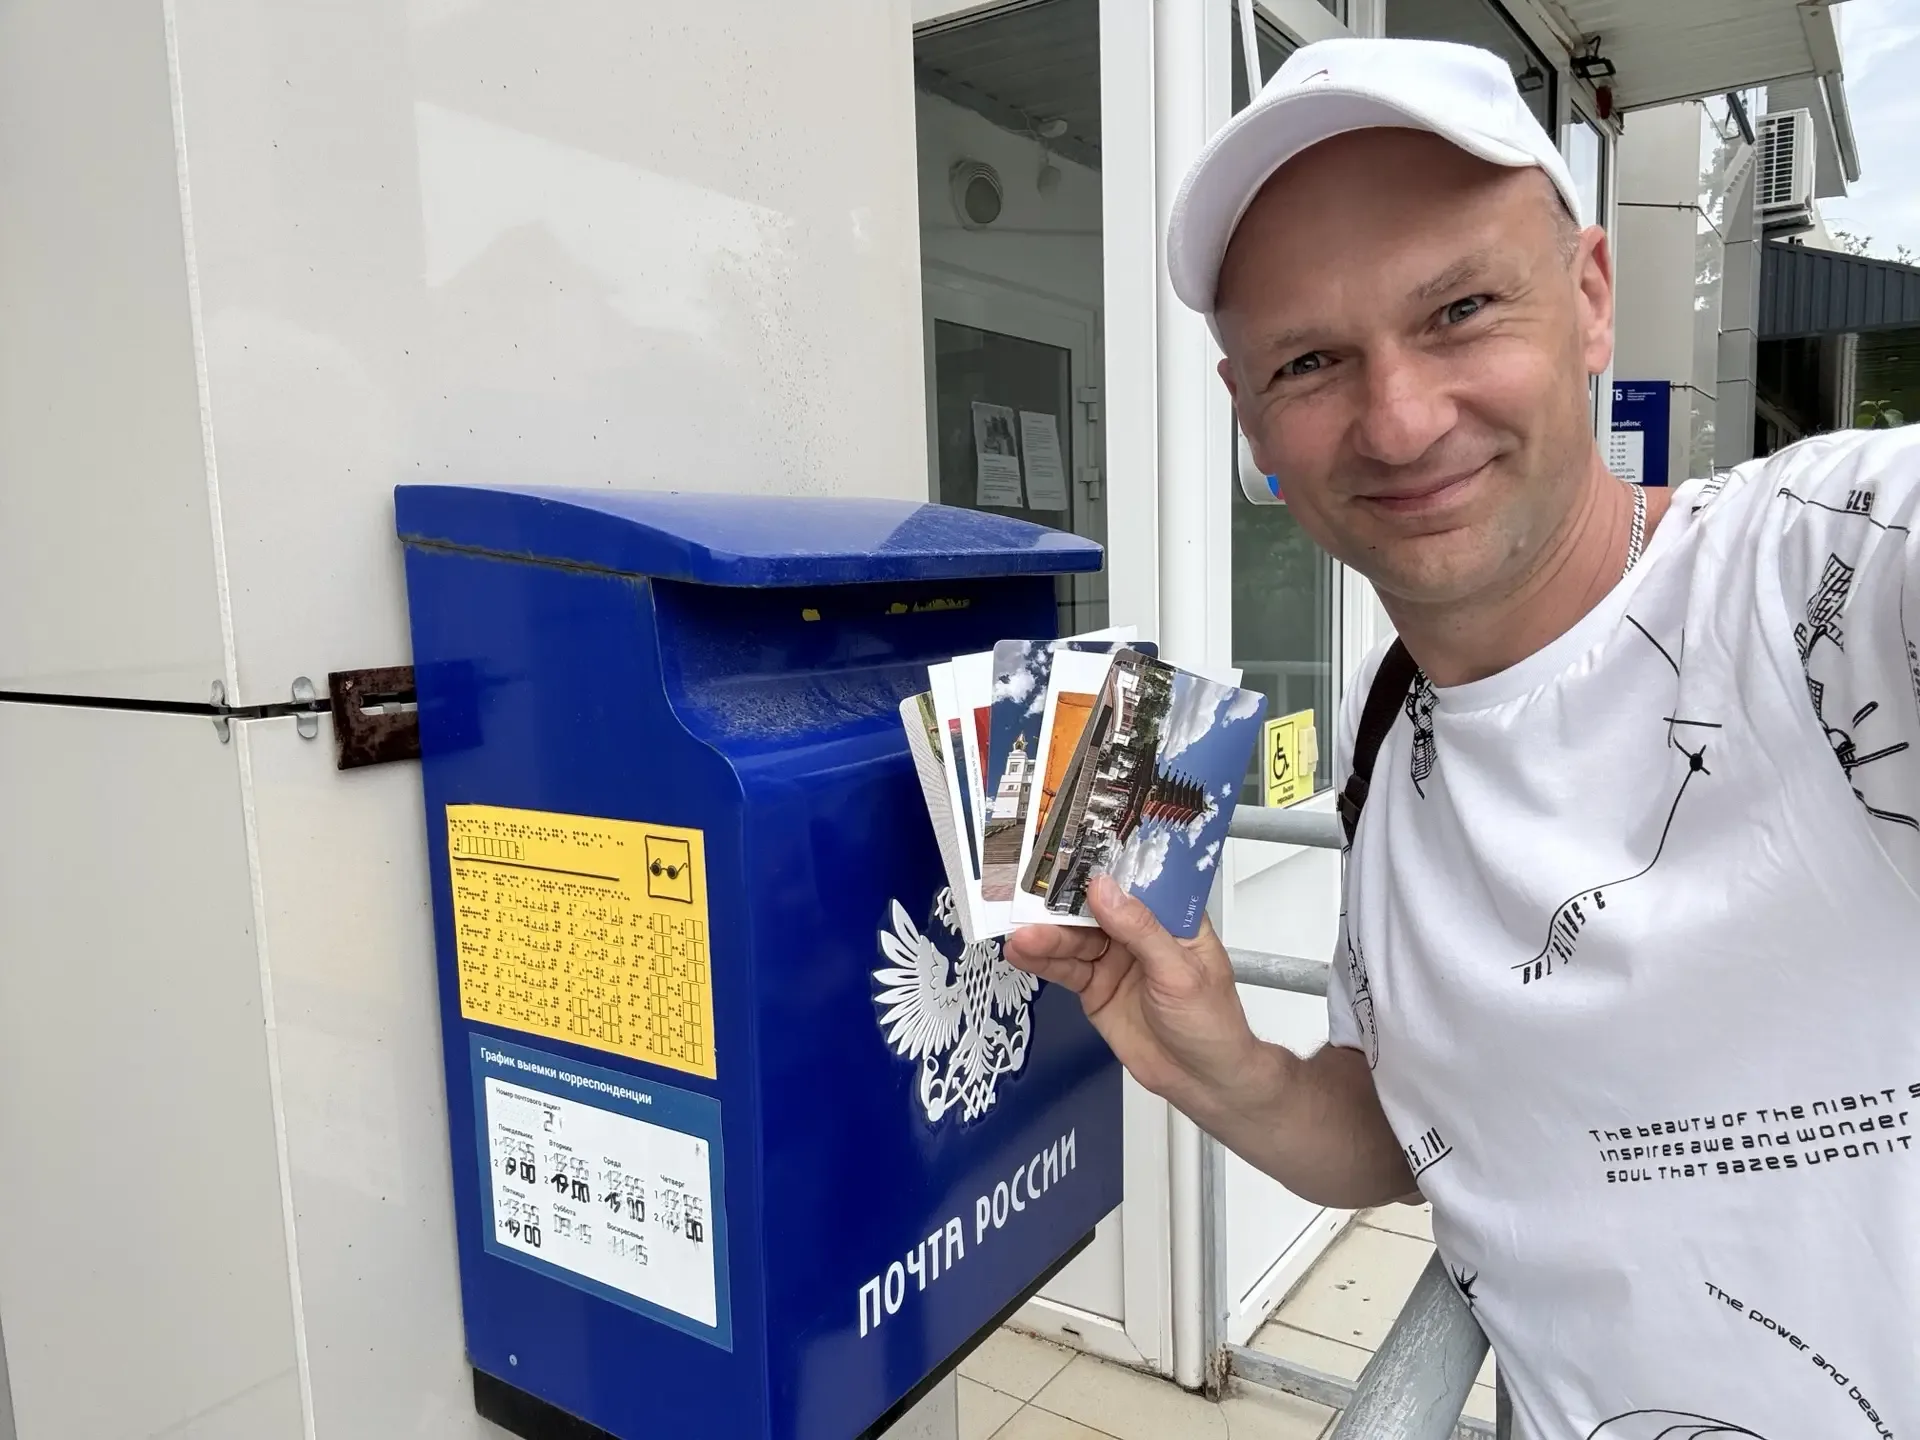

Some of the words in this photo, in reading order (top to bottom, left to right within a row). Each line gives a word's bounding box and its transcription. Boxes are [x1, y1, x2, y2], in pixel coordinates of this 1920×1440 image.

[481, 1047, 515, 1068] График
[517, 1059, 557, 1079] выемки
[558, 1071, 653, 1105] корреспонденции
[498, 1123, 534, 1140] Понедельник
[1589, 1127, 1633, 1142] The
[1741, 1131, 1790, 1149] and
[549, 1139, 573, 1152] Вторник
[858, 1216, 965, 1339] ПОЧТА
[975, 1127, 1077, 1245] РОССИИ
[1704, 1281, 1744, 1313] The
[1748, 1309, 1811, 1352] power
[1811, 1352, 1850, 1387] and
